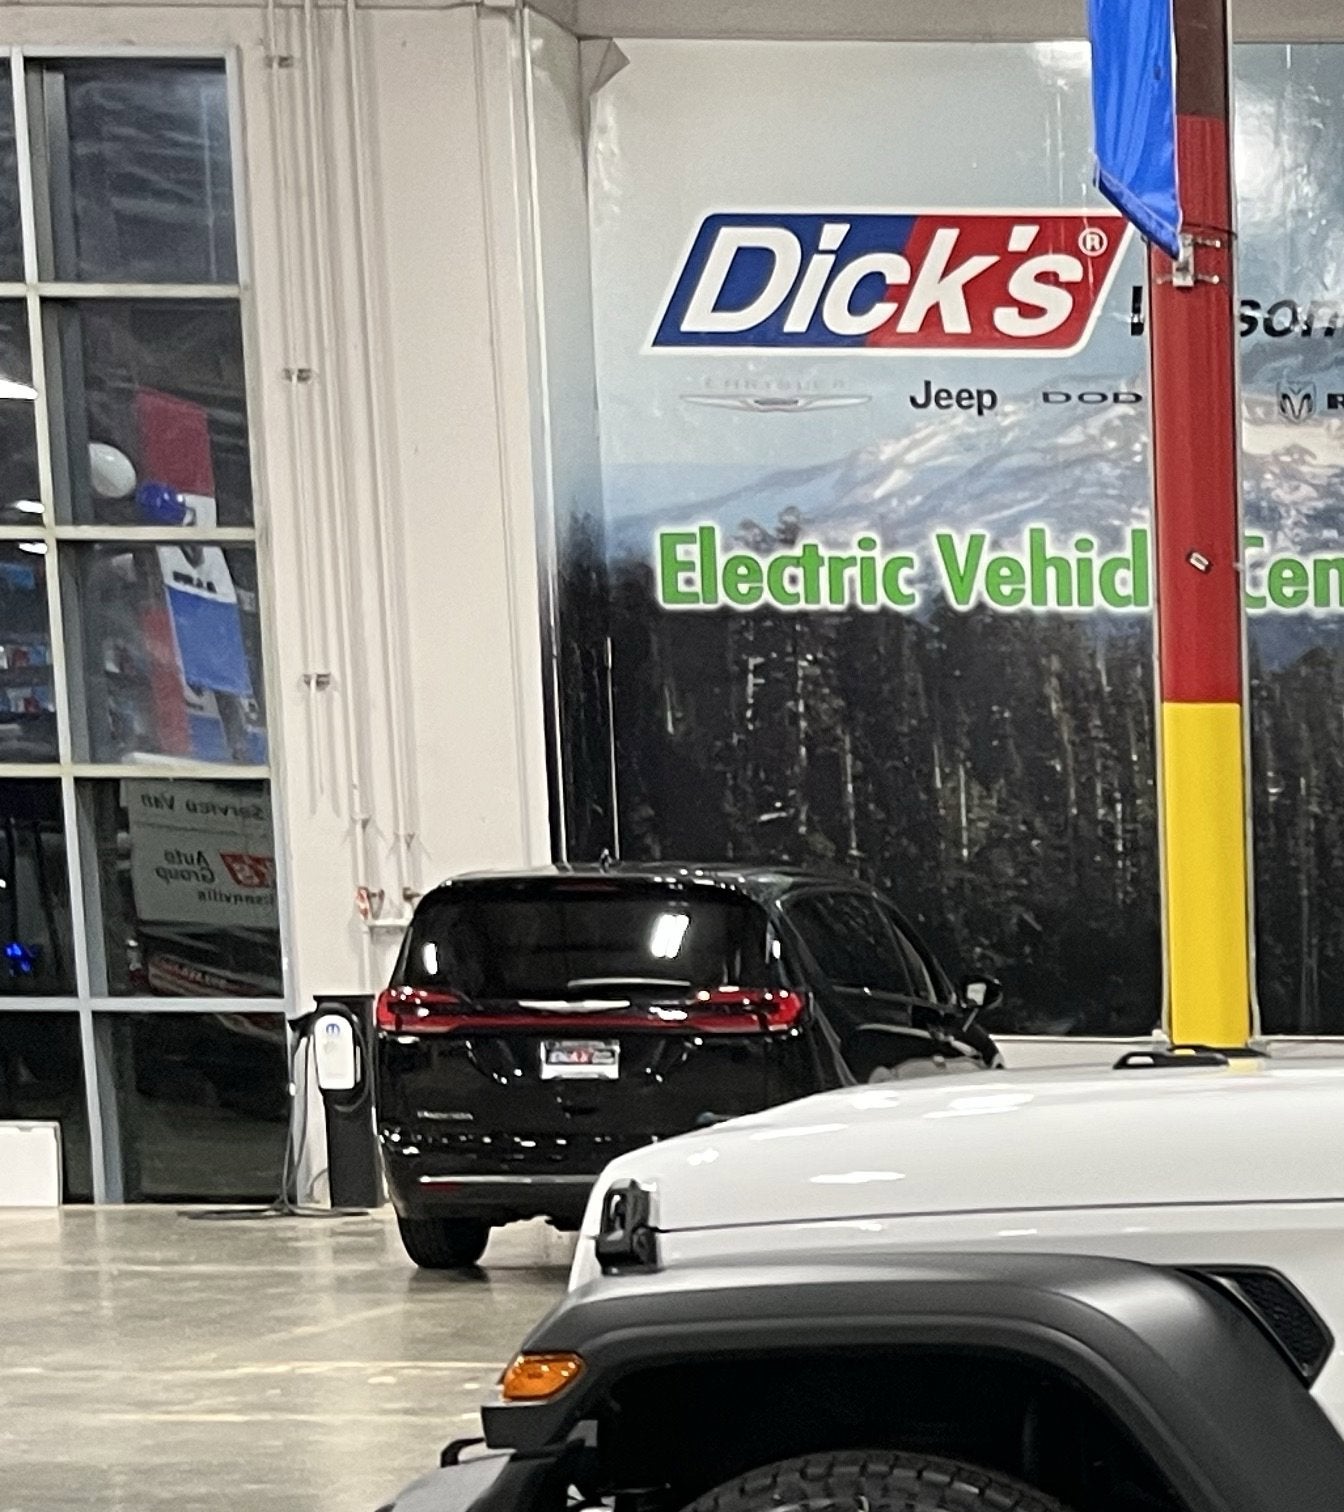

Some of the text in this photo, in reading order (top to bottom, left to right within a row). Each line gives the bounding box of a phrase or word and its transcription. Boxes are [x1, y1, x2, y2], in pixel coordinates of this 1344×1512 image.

[680, 222, 1084, 338] Dick's
[909, 379, 999, 416] Jeep
[1042, 391, 1144, 405] DOD
[659, 525, 916, 607] Electric
[936, 527, 1149, 608] Vehicl
